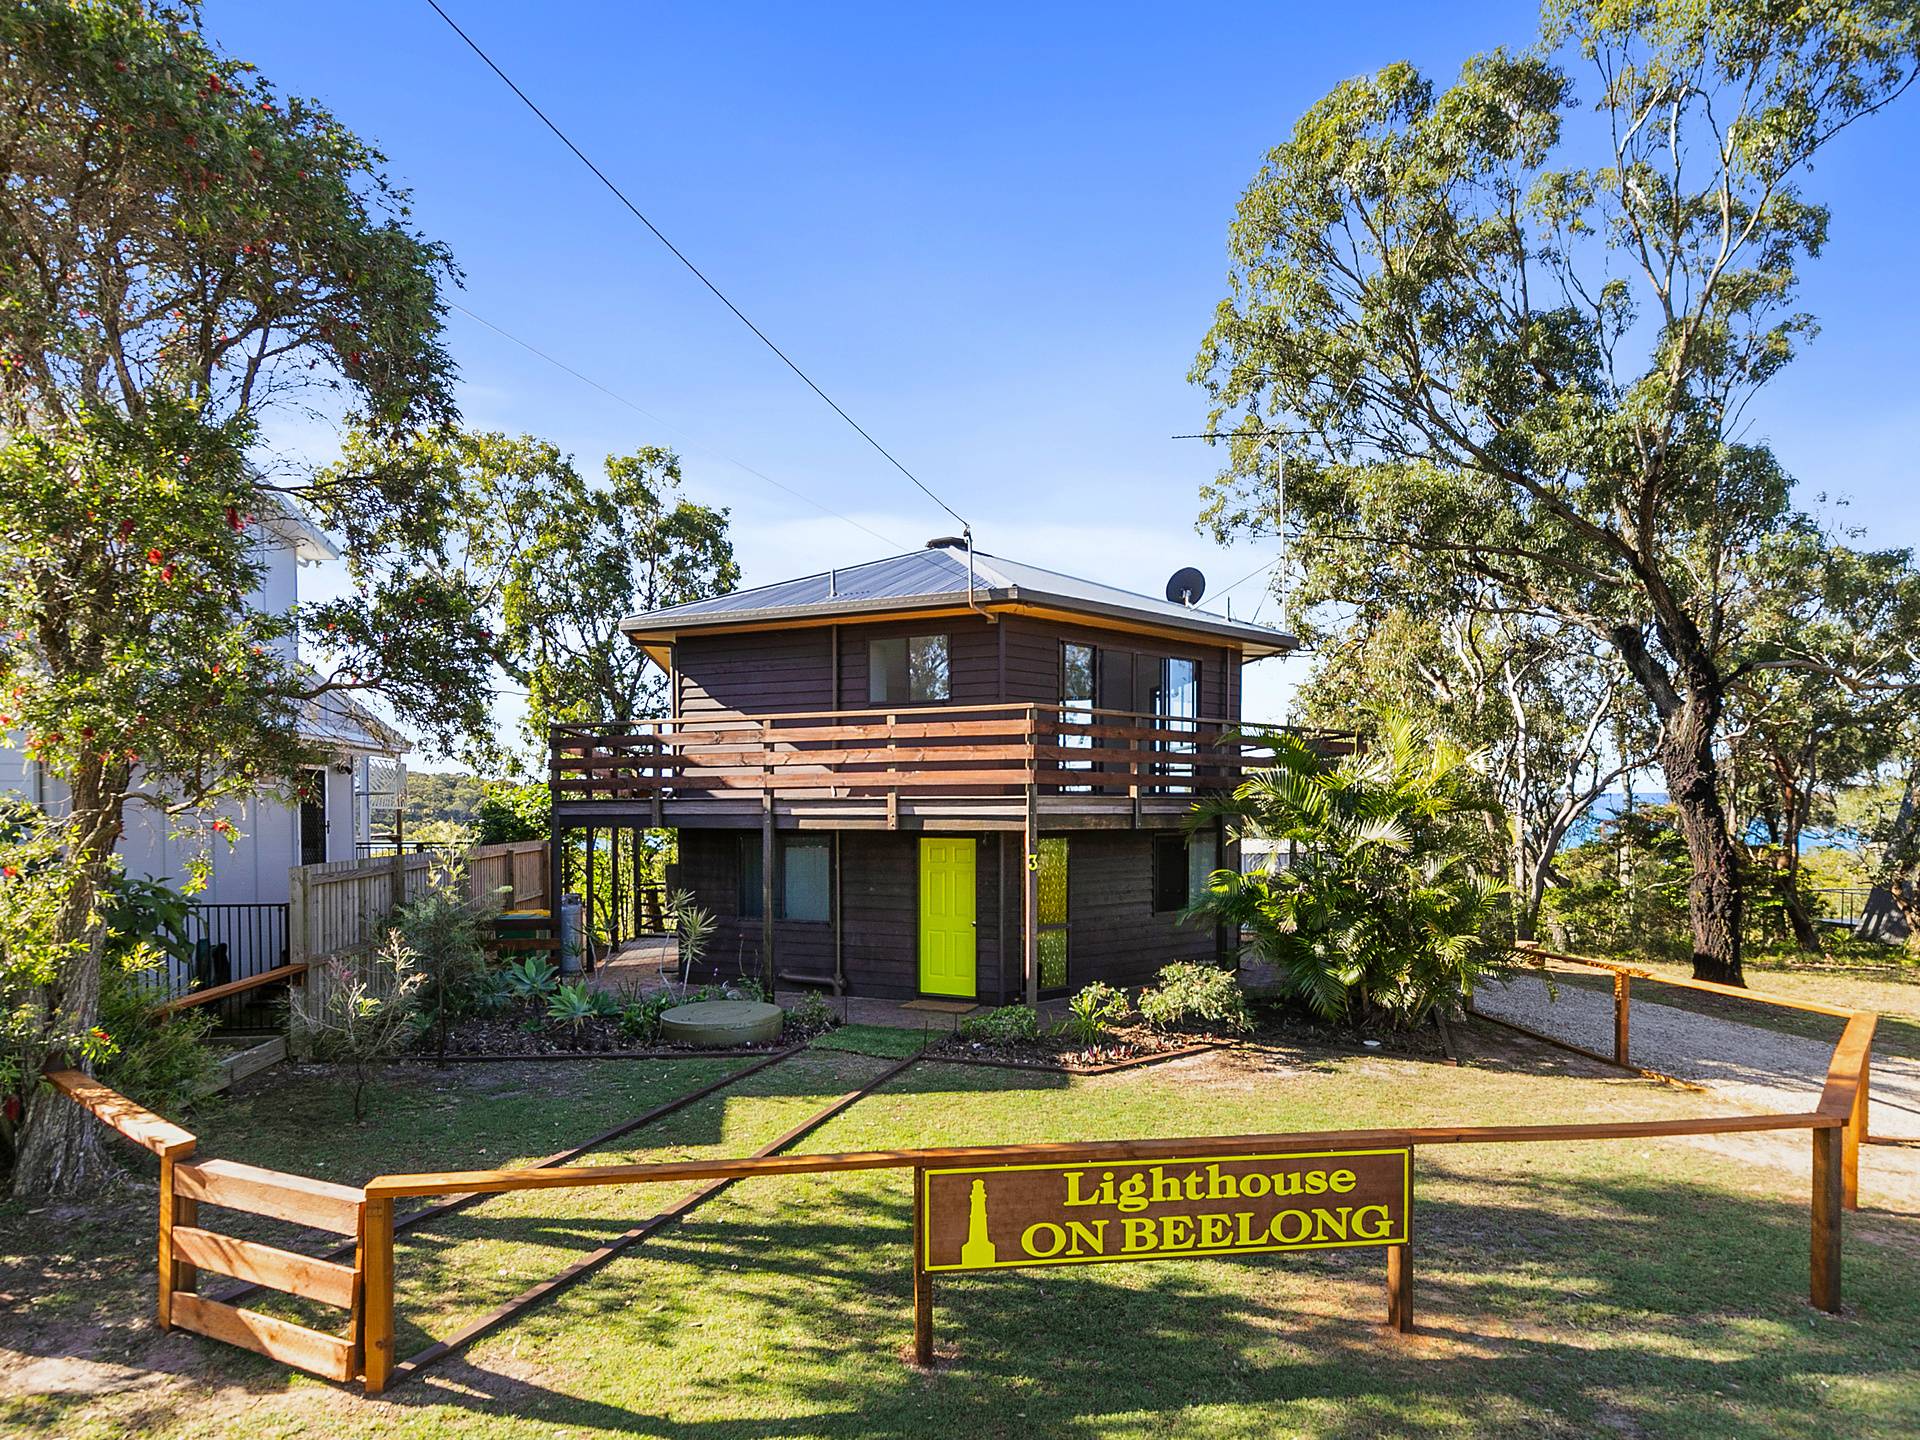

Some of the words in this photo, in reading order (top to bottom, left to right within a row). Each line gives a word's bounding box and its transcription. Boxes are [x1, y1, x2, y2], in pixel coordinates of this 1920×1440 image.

[1028, 854, 1038, 871] 3
[1063, 1165, 1357, 1211] Lighthouse
[1021, 1220, 1109, 1257] ON
[1121, 1205, 1394, 1251] BEELONG
